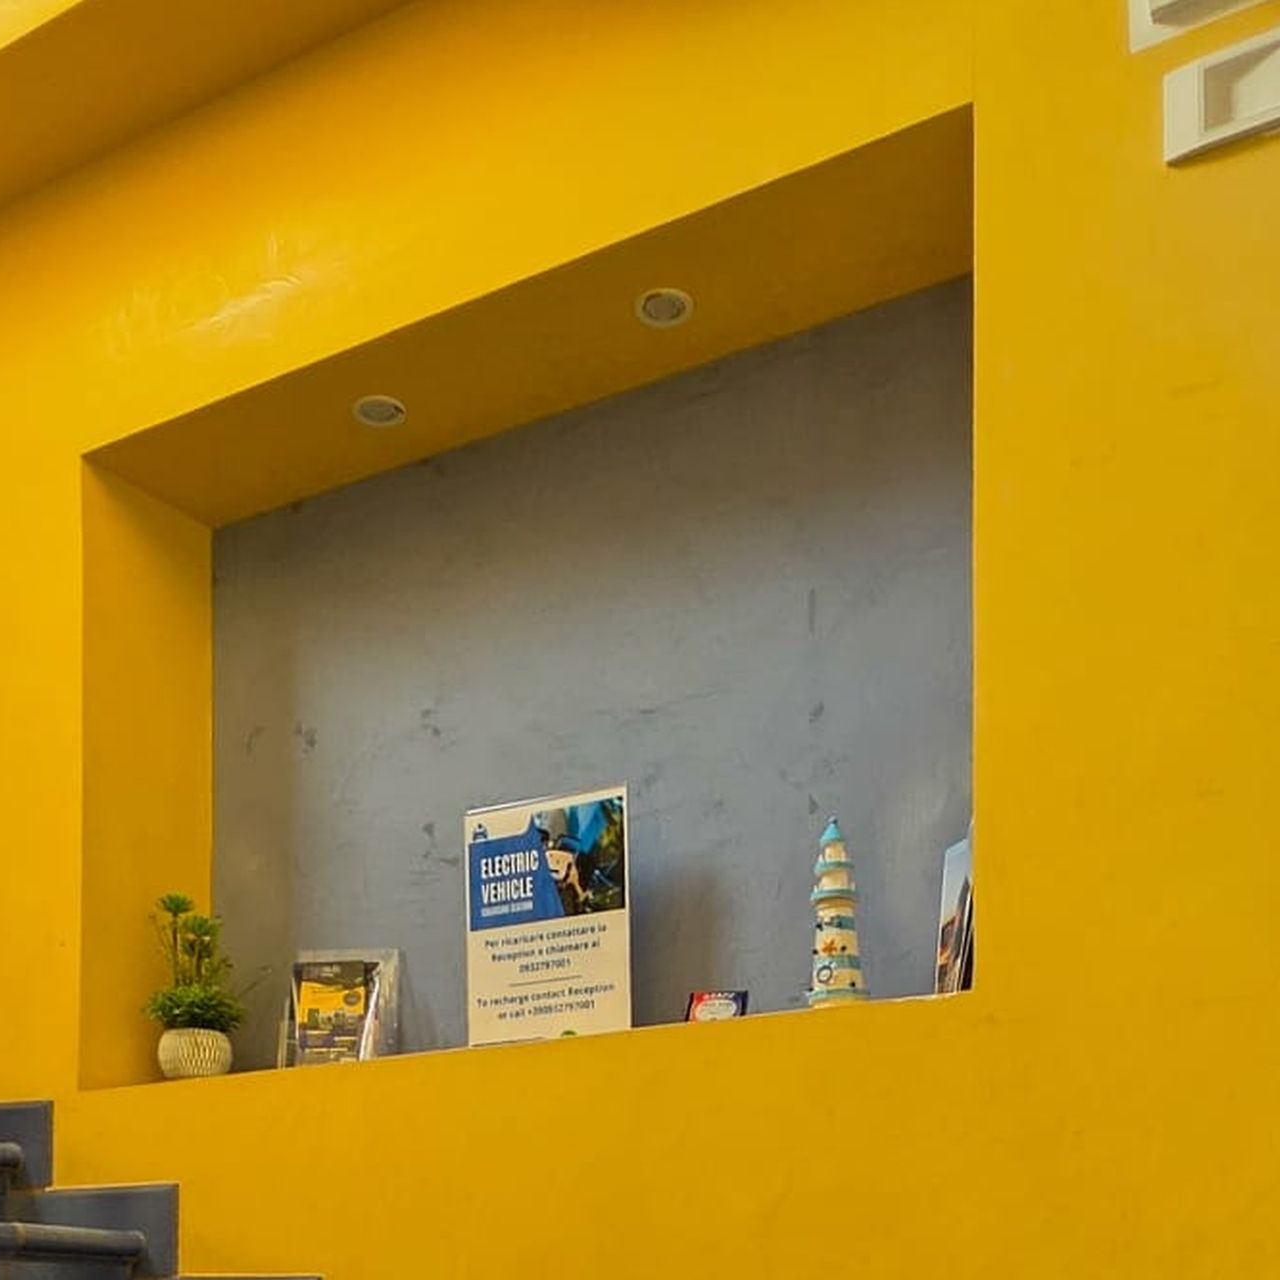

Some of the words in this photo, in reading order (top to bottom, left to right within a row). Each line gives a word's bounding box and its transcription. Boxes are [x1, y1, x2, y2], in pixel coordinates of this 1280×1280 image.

[481, 850, 539, 879] ELECTRIC
[482, 877, 533, 904] VEHICLE
[477, 997, 487, 1008] To
[531, 987, 566, 1001] contact
